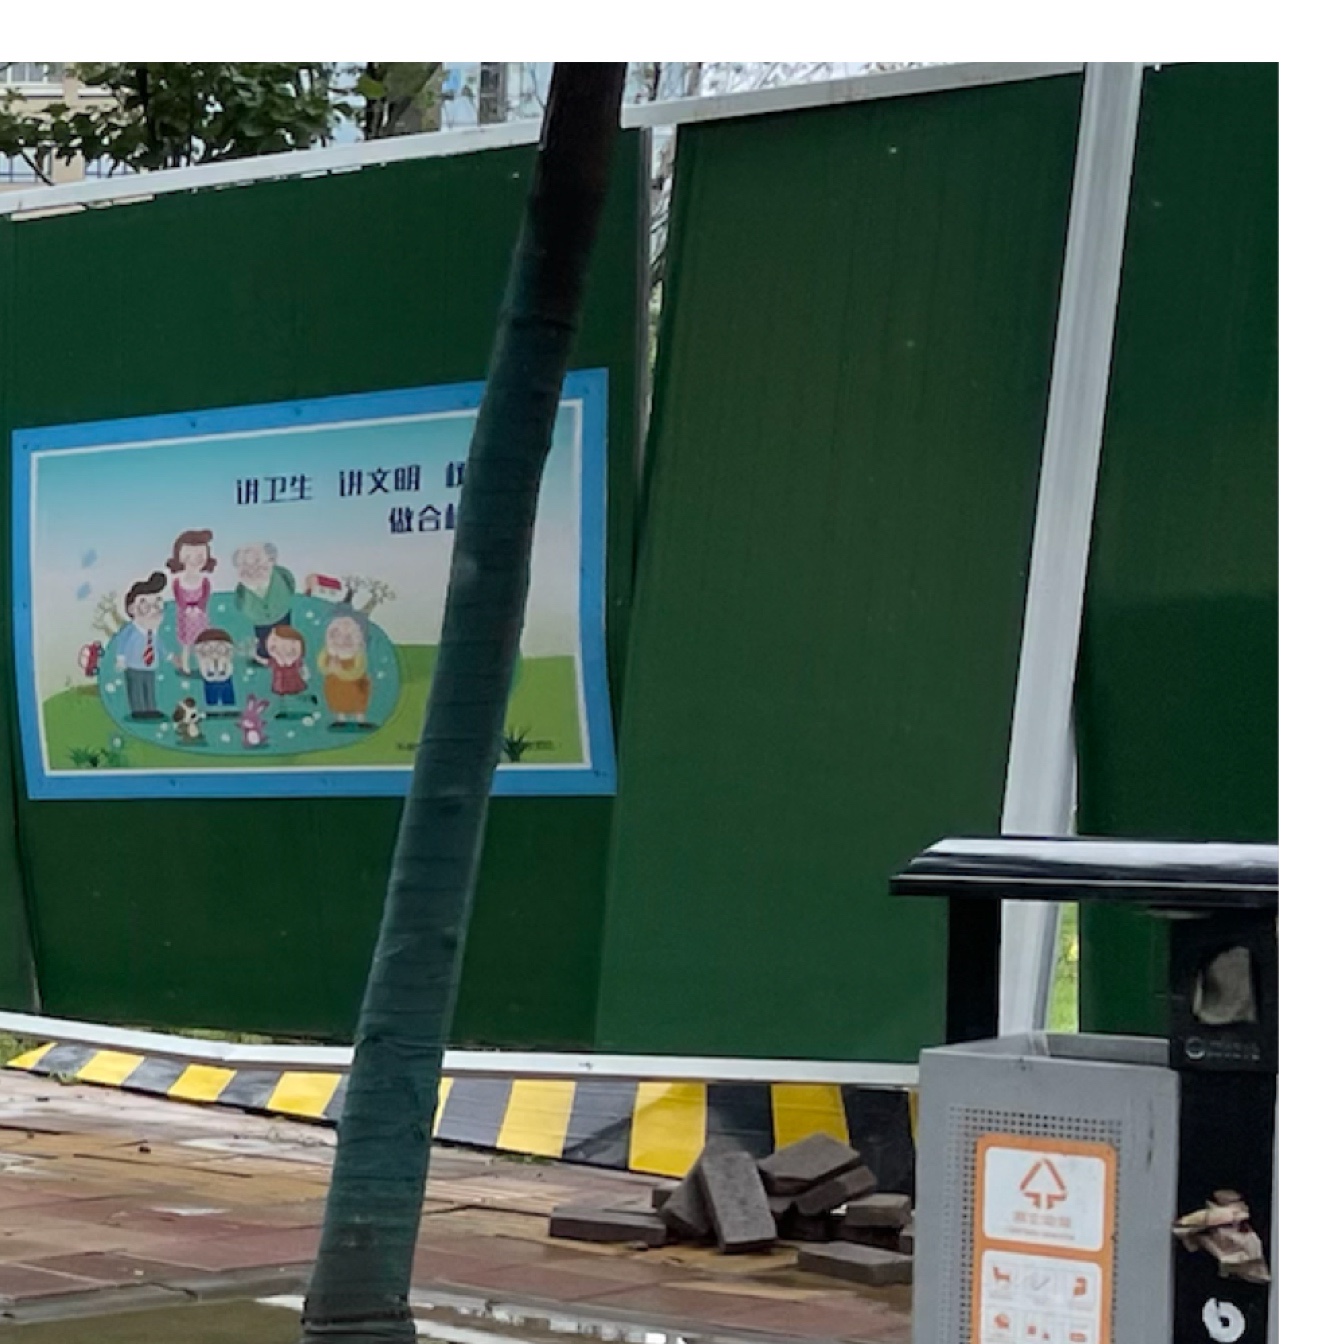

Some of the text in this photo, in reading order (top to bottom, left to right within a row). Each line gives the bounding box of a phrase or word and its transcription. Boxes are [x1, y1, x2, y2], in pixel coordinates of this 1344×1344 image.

[236, 473, 313, 505] 讲卫生
[338, 464, 421, 497] 讲文明
